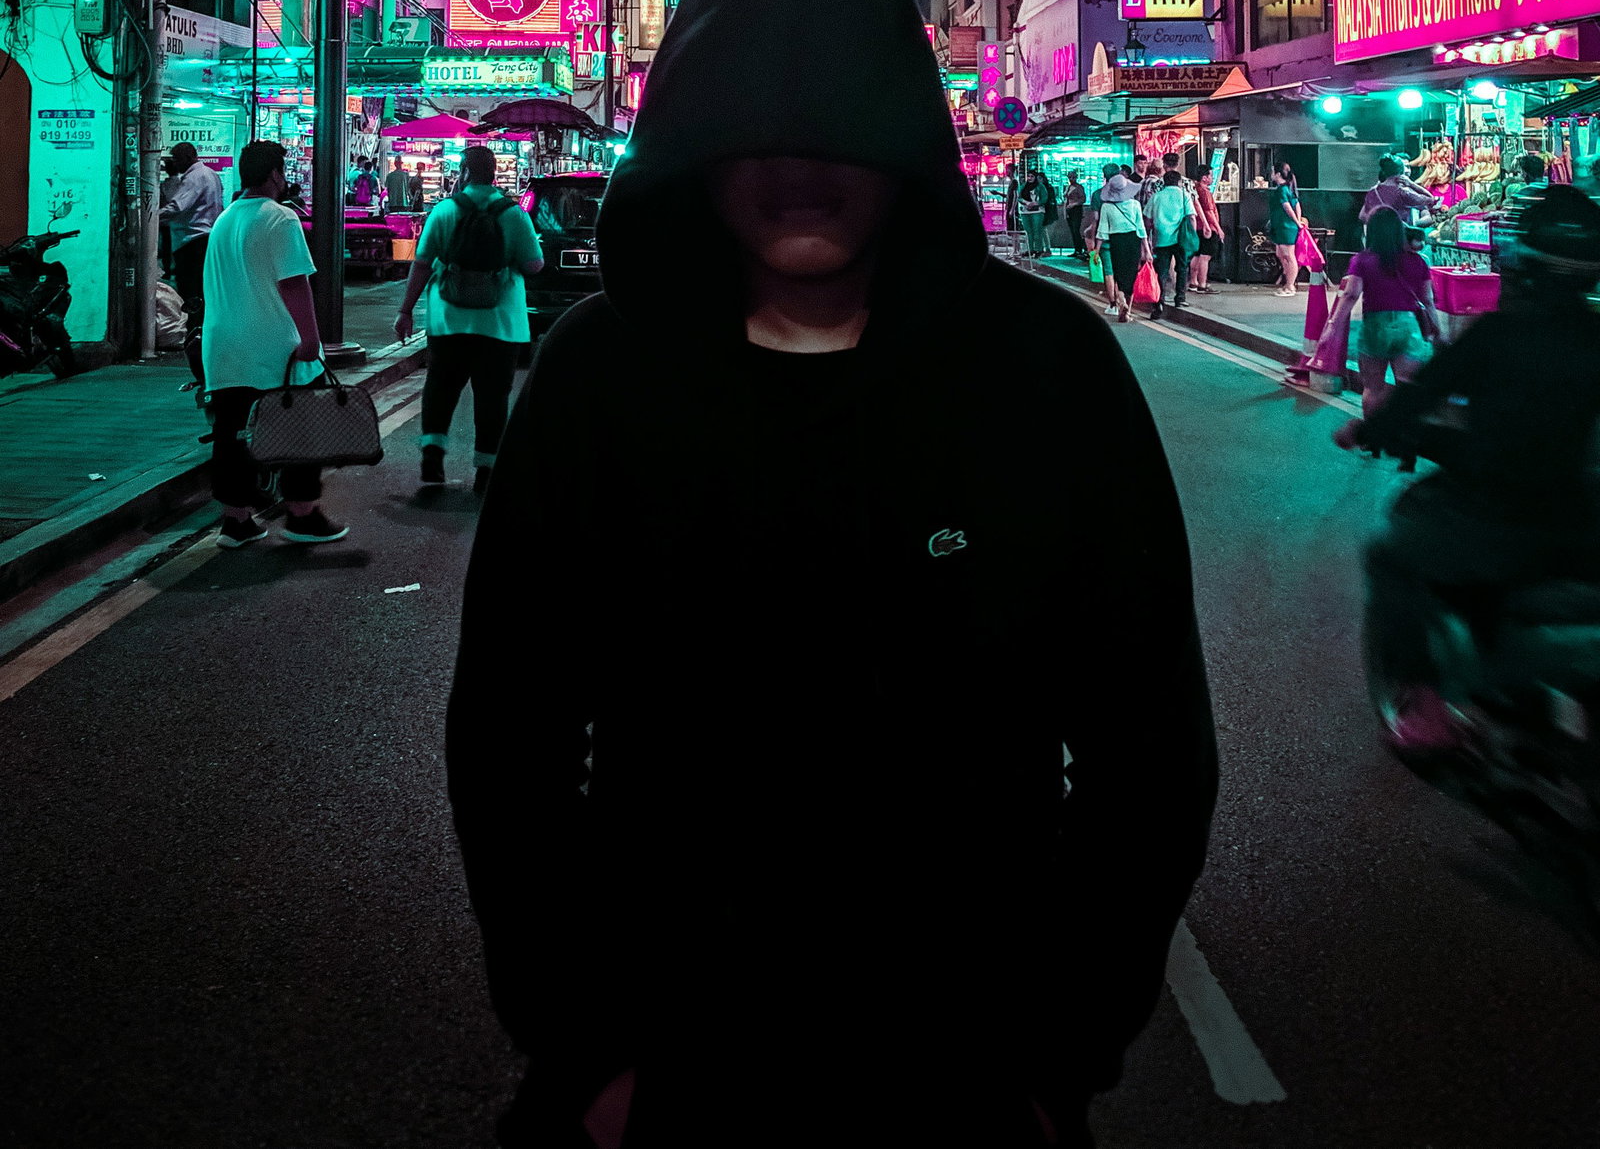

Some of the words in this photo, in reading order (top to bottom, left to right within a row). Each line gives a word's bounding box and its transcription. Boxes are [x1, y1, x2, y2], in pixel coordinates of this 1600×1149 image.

[166, 37, 185, 56] BHD.
[427, 67, 481, 81] HOTEL
[518, 62, 539, 74] City
[1120, 82, 1159, 90] MALAYSIA
[1198, 81, 1213, 89] DRY
[56, 120, 77, 129] 010
[66, 131, 92, 140] 1499
[170, 130, 215, 142] HOTEL
[578, 253, 589, 264] VJ
